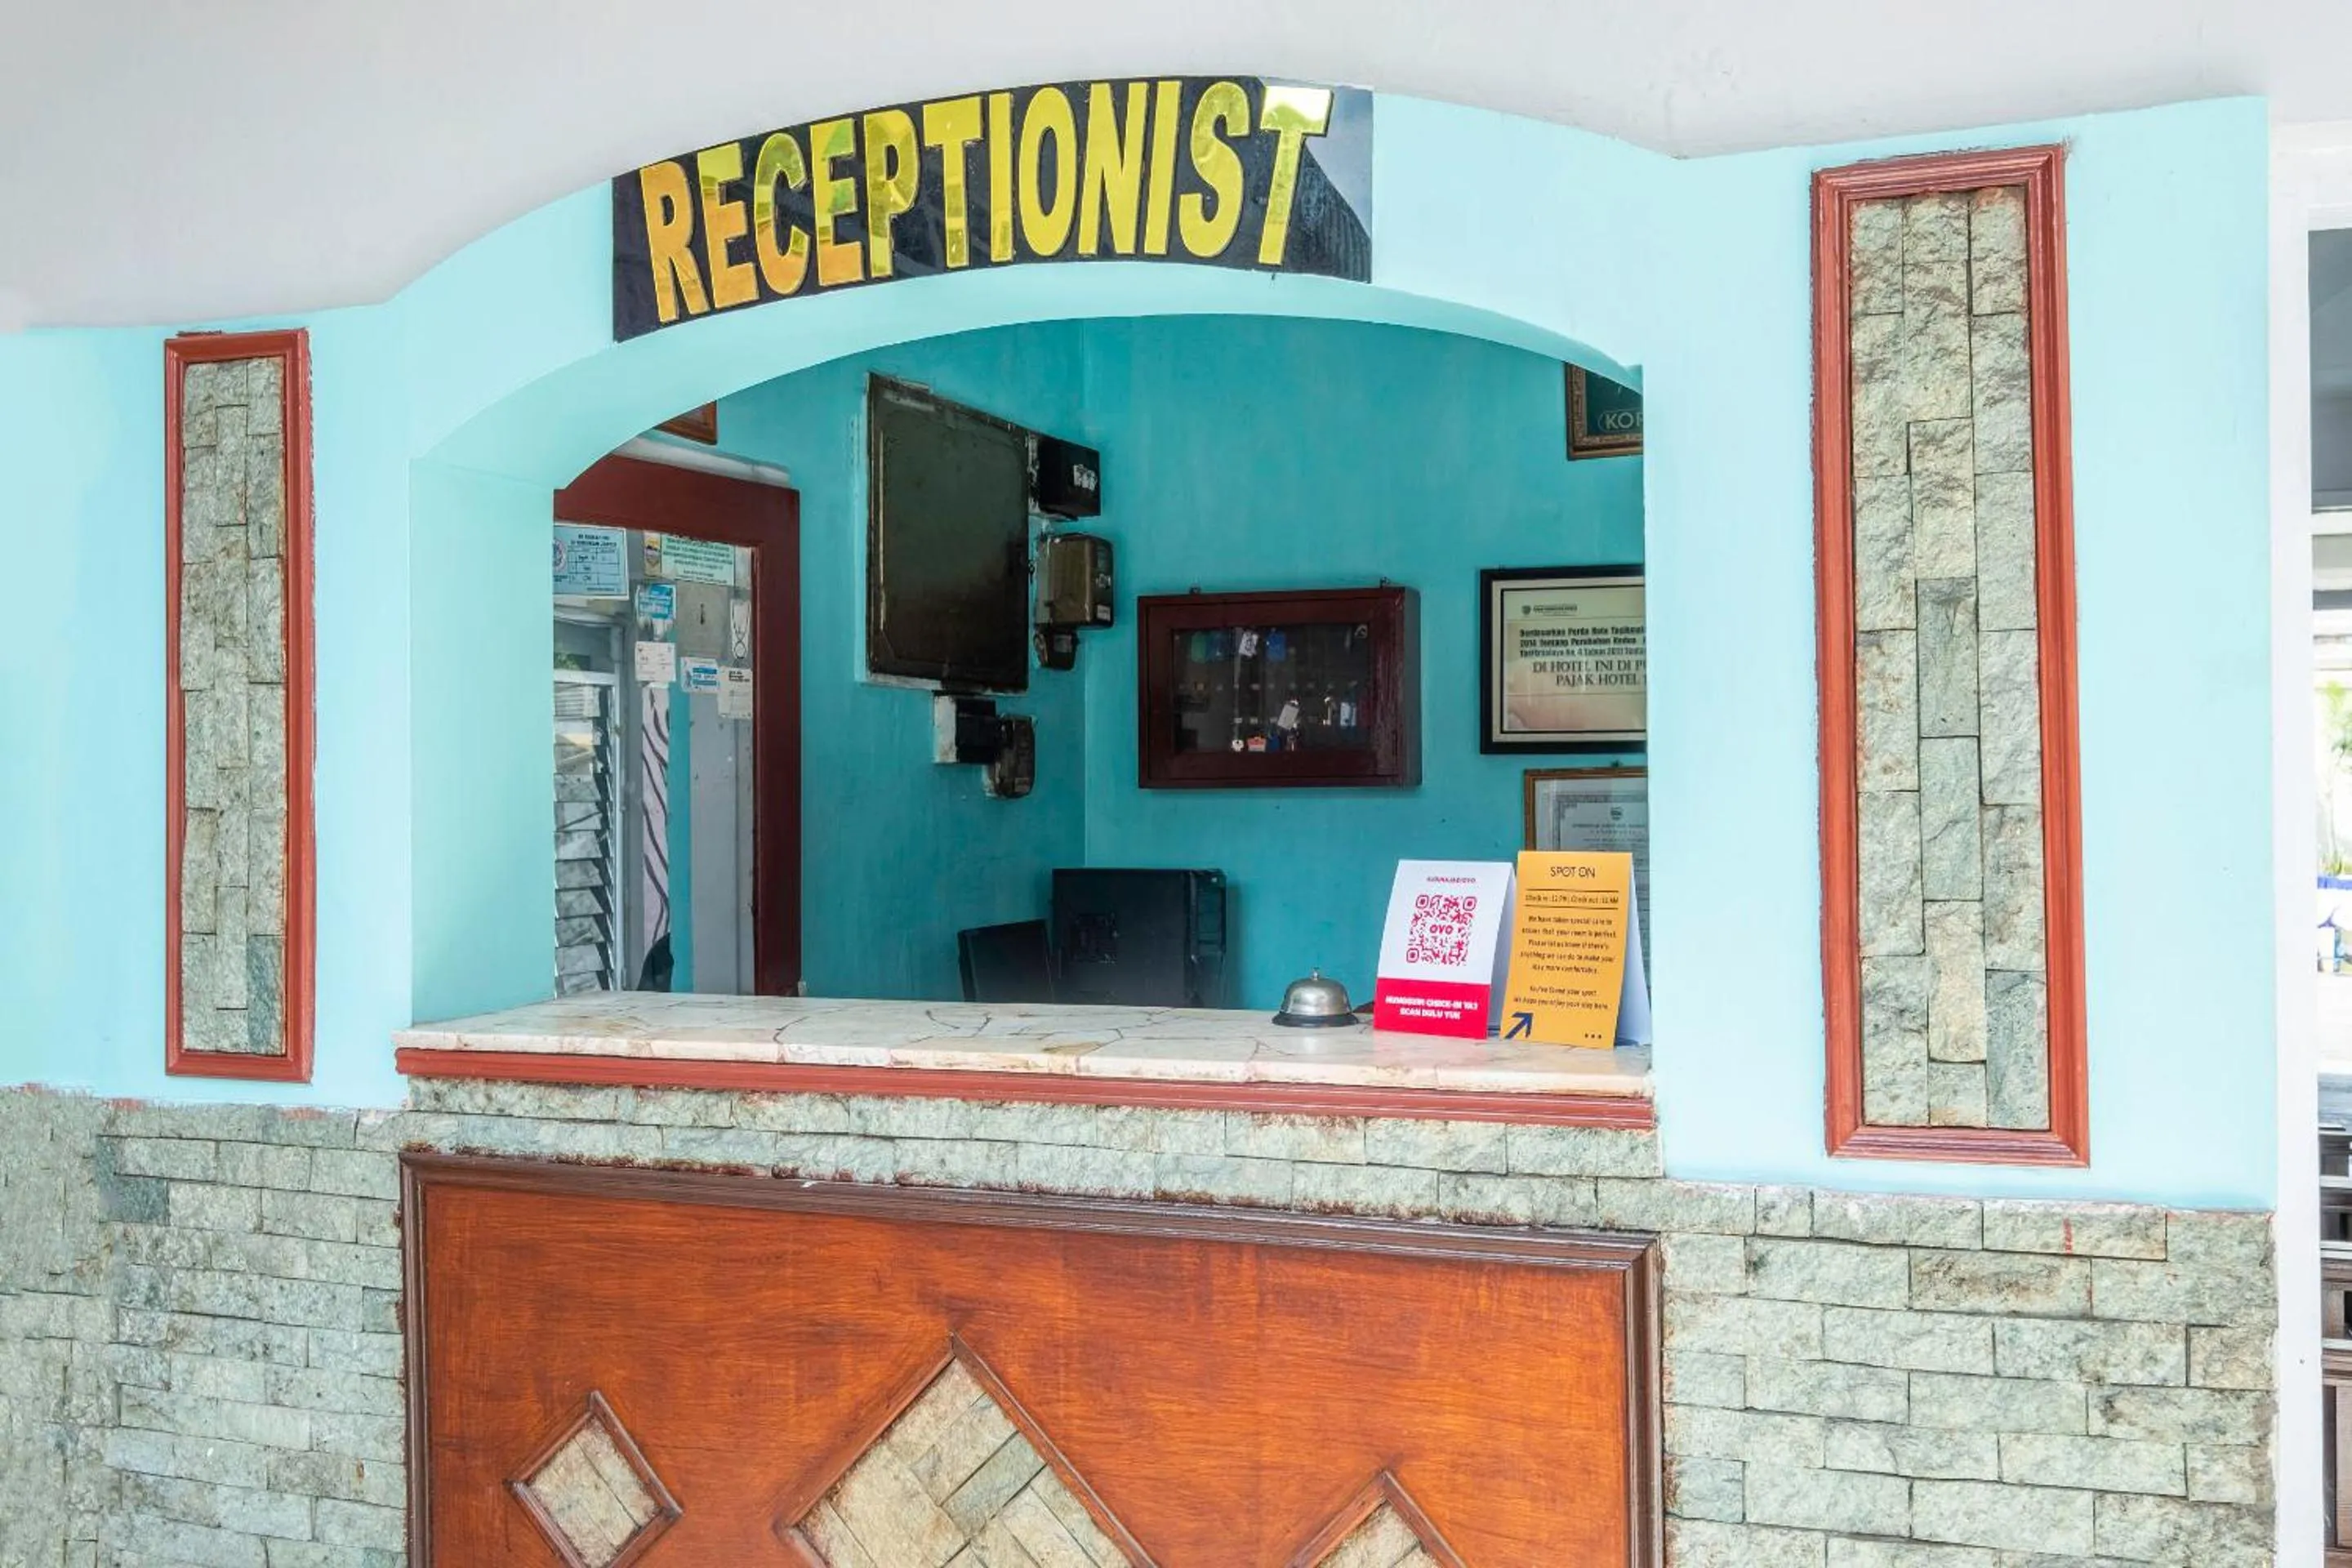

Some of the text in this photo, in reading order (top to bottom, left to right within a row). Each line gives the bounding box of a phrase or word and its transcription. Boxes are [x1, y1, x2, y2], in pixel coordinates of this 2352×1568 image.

[639, 79, 1333, 325] RECEPTIONIST
[1551, 661, 1592, 672] HOTEL
[1596, 660, 1613, 671] INI
[1556, 675, 1595, 687] PAJAK
[1598, 674, 1639, 685] HOTEL
[1550, 866, 1596, 878] SPOT ON
